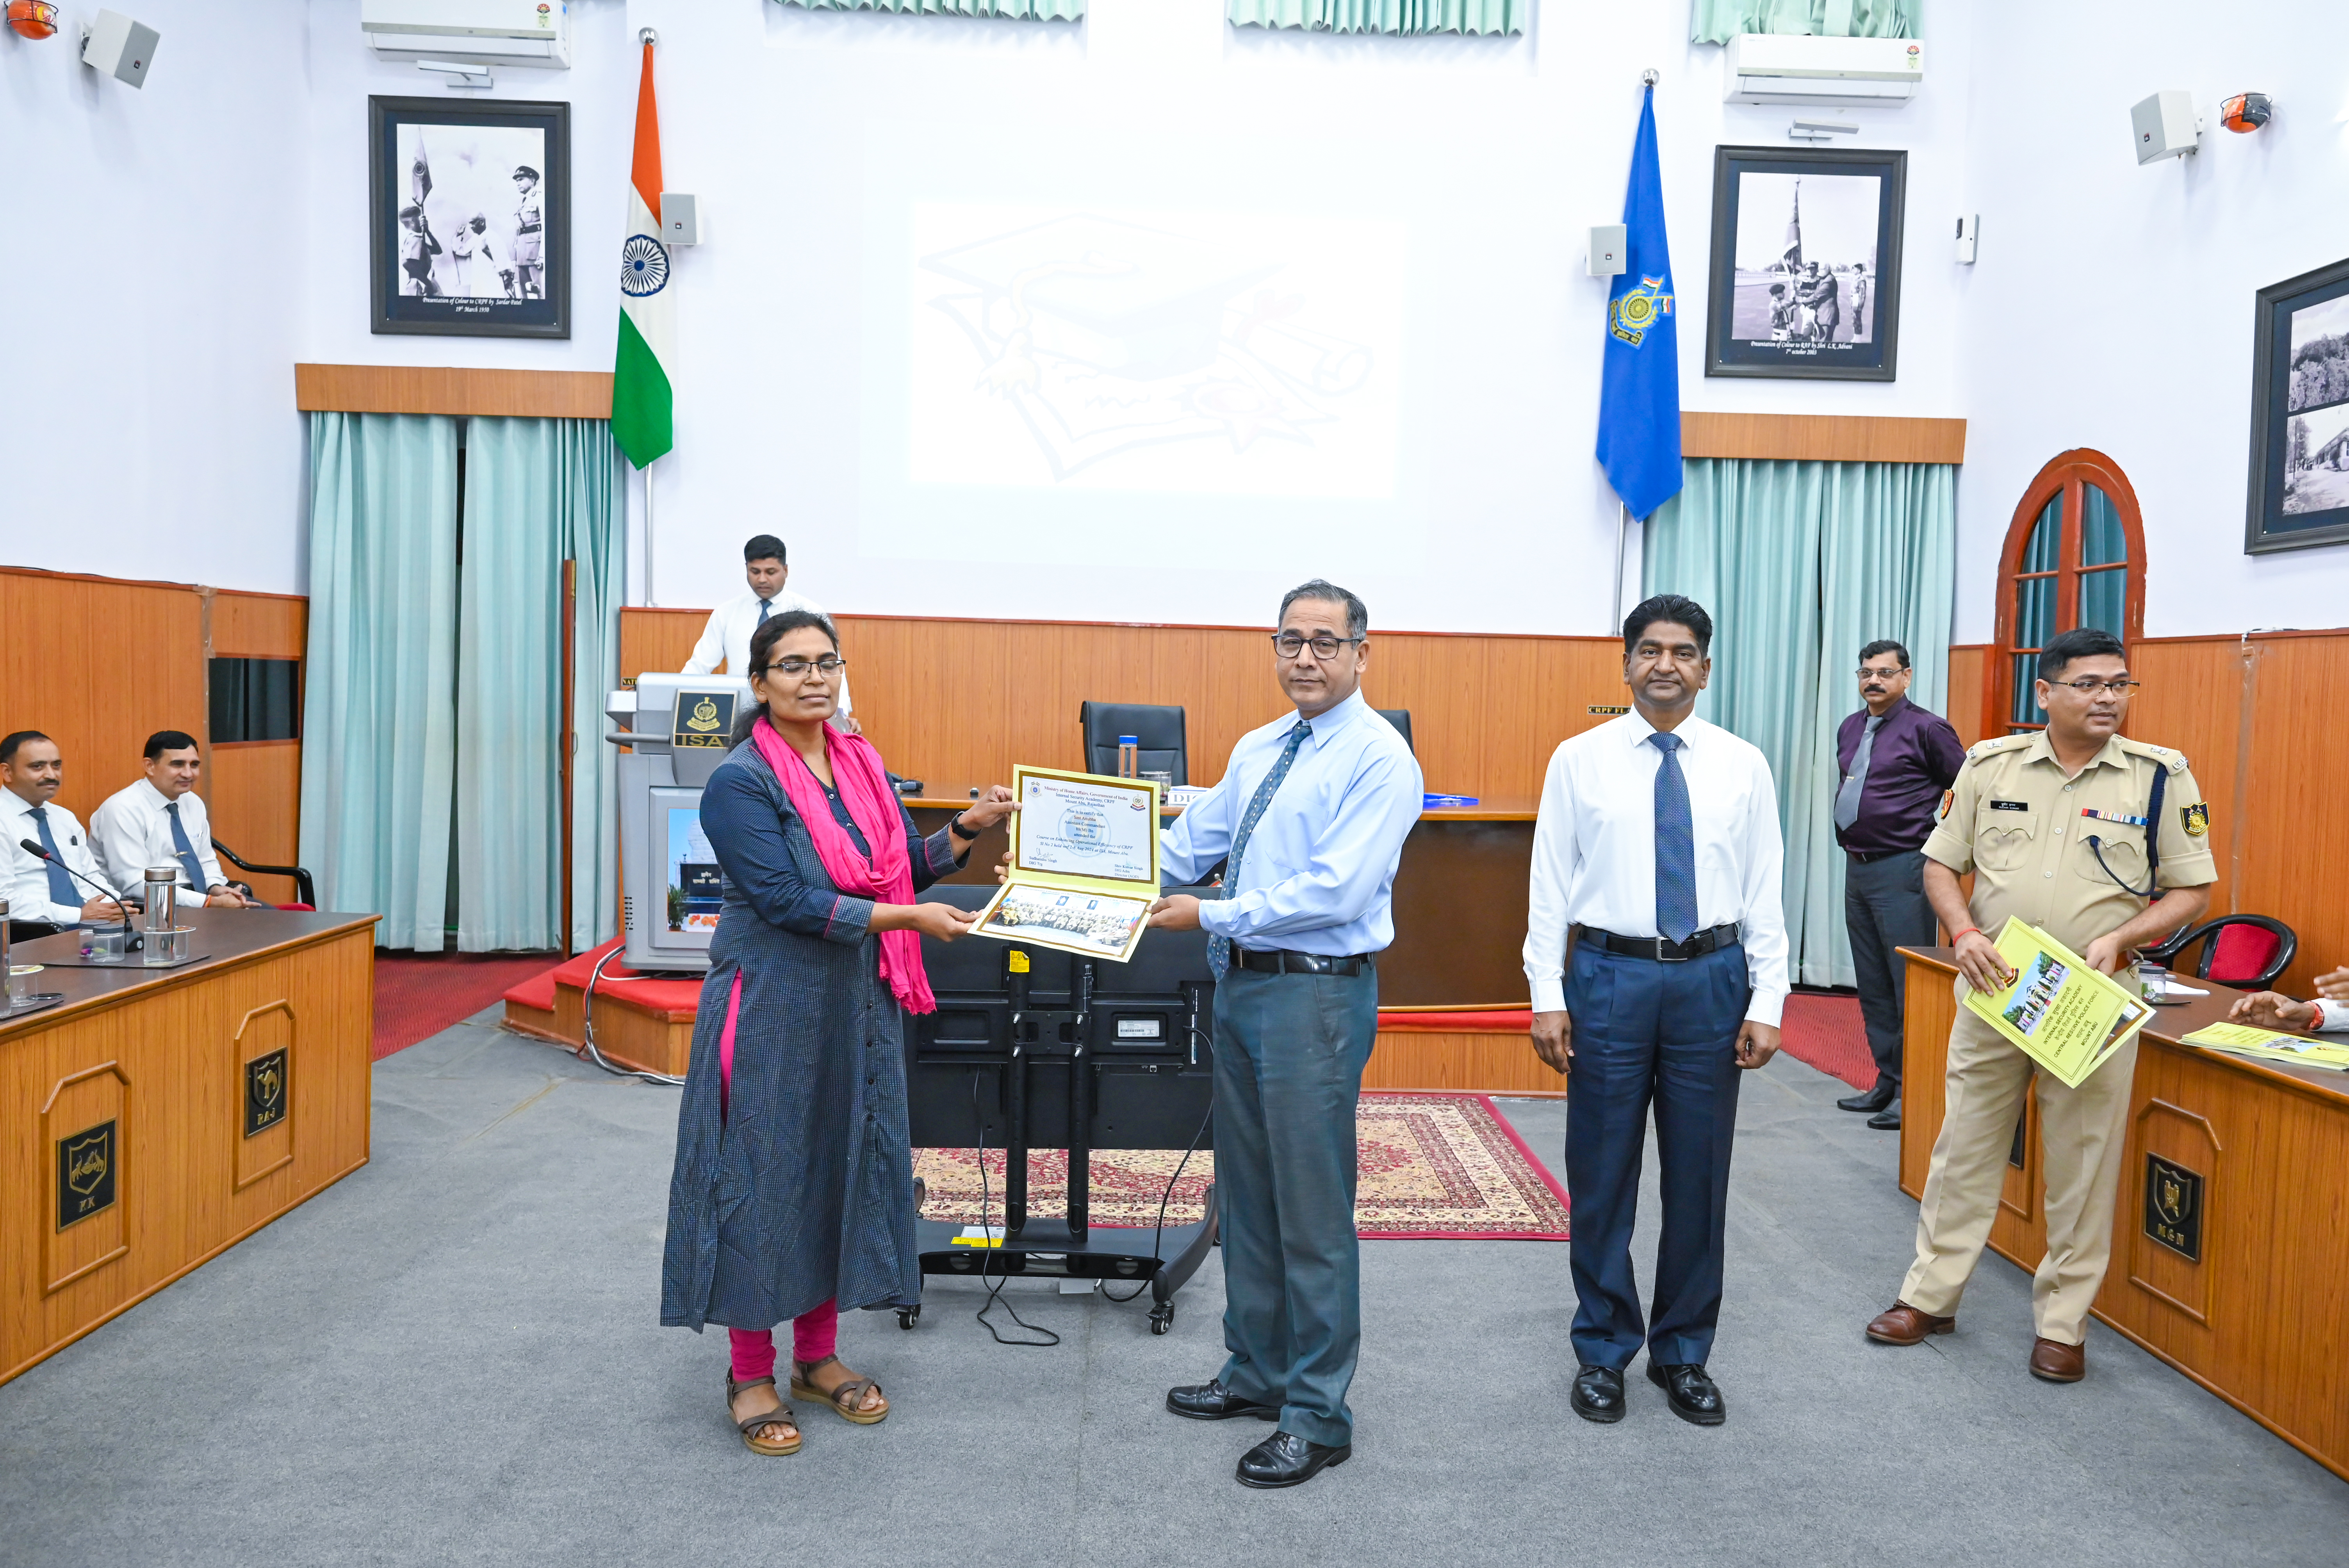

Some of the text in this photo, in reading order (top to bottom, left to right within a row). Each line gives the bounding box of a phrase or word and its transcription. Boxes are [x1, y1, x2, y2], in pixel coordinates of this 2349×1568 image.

[682, 735, 723, 747] ISA
[2043, 984, 2082, 1044] INTERNAL SECURITY ACADEMY
[2054, 990, 2099, 1057] CENTRAL RESERVE POLICE FORCE
[2081, 1031, 2092, 1046] MOUNT
[257, 1108, 275, 1125] RAJ
[79, 1196, 95, 1212] KK
